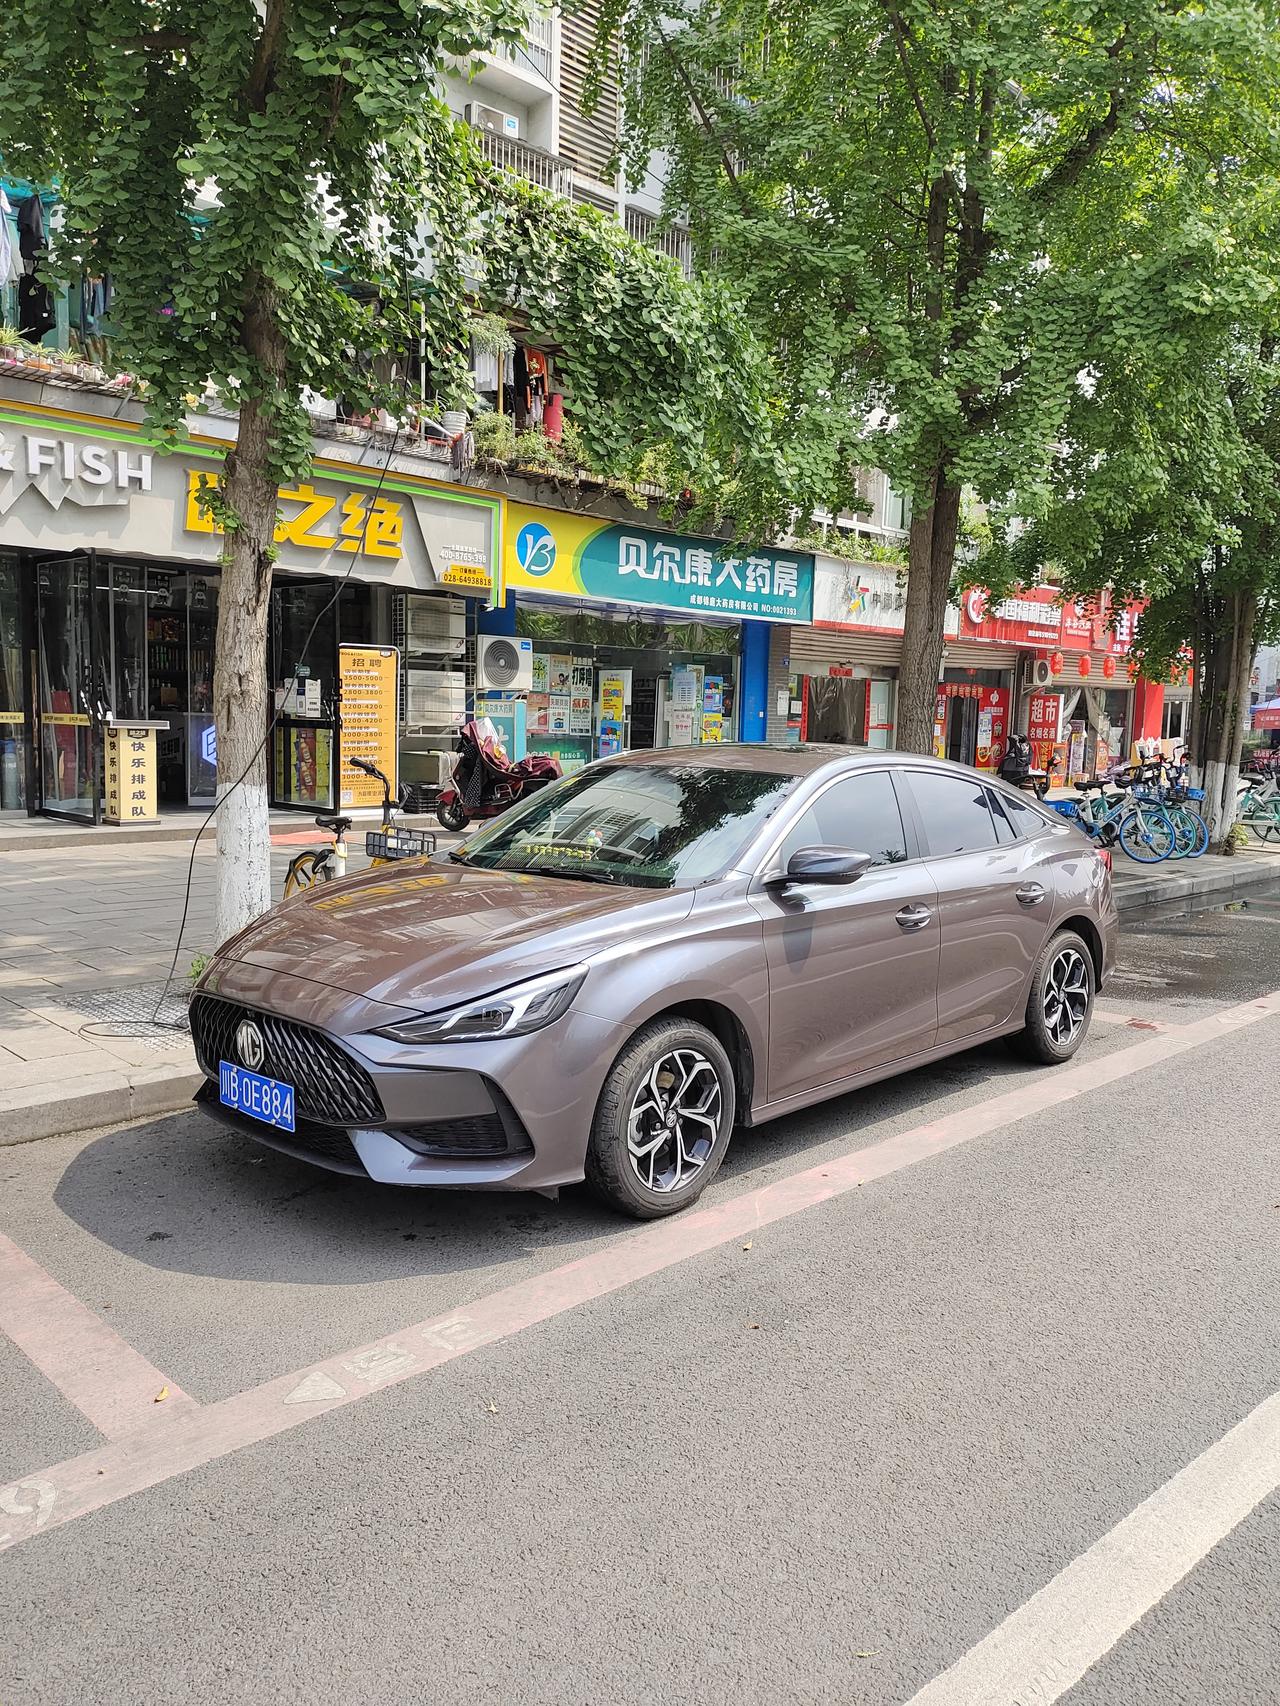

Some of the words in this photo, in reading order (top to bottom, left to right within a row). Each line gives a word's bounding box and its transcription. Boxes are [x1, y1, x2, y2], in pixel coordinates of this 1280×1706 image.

[25, 436, 152, 490] FISH
[618, 536, 799, 598] 贝尔康大药房
[352, 658, 382, 667] 招聘
[1030, 727, 1056, 739] 名烟名酒
[1031, 698, 1057, 723] 超市
[109, 741, 117, 816] 快乐排成队
[131, 742, 146, 816] 快乐排成队
[237, 1024, 262, 1067] MG
